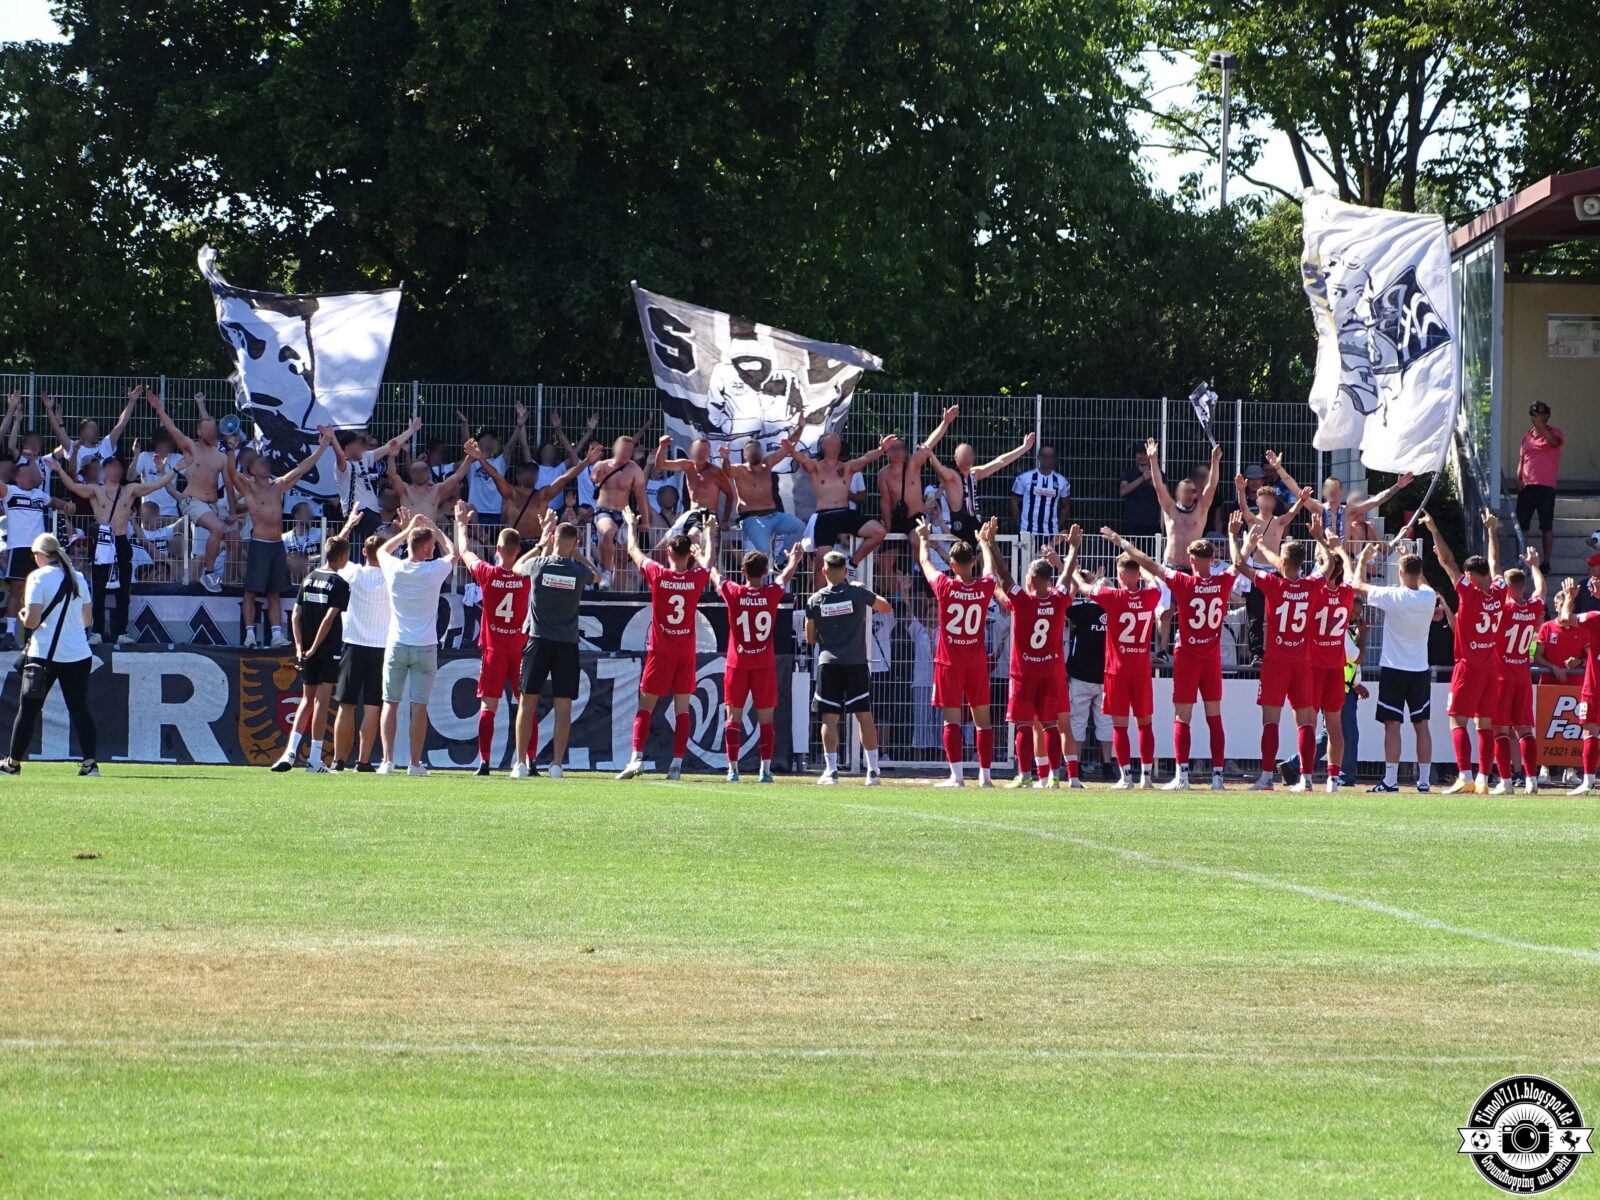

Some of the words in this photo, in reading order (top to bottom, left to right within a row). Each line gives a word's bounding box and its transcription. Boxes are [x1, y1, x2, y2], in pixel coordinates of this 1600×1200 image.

[660, 579, 696, 591] HECKMANN
[949, 590, 986, 600] PORTELLA
[1194, 585, 1222, 594] SCHMIDT
[495, 592, 514, 623] 4
[666, 594, 685, 625] 3
[739, 597, 768, 606] MÜLLER
[1037, 607, 1055, 616] KORB
[1127, 601, 1144, 610] VOLZ
[1188, 597, 1223, 630] 36
[1275, 600, 1309, 633] 15
[736, 610, 772, 642] 19
[945, 603, 982, 636] 20
[1030, 618, 1050, 650] 8
[1091, 624, 1108, 632] FLA
[1118, 611, 1153, 643] 27
[1314, 606, 1348, 637] 12
[1504, 623, 1535, 655] 10
[1545, 719, 1586, 740] Fa
[1543, 746, 1568, 757] 74321
